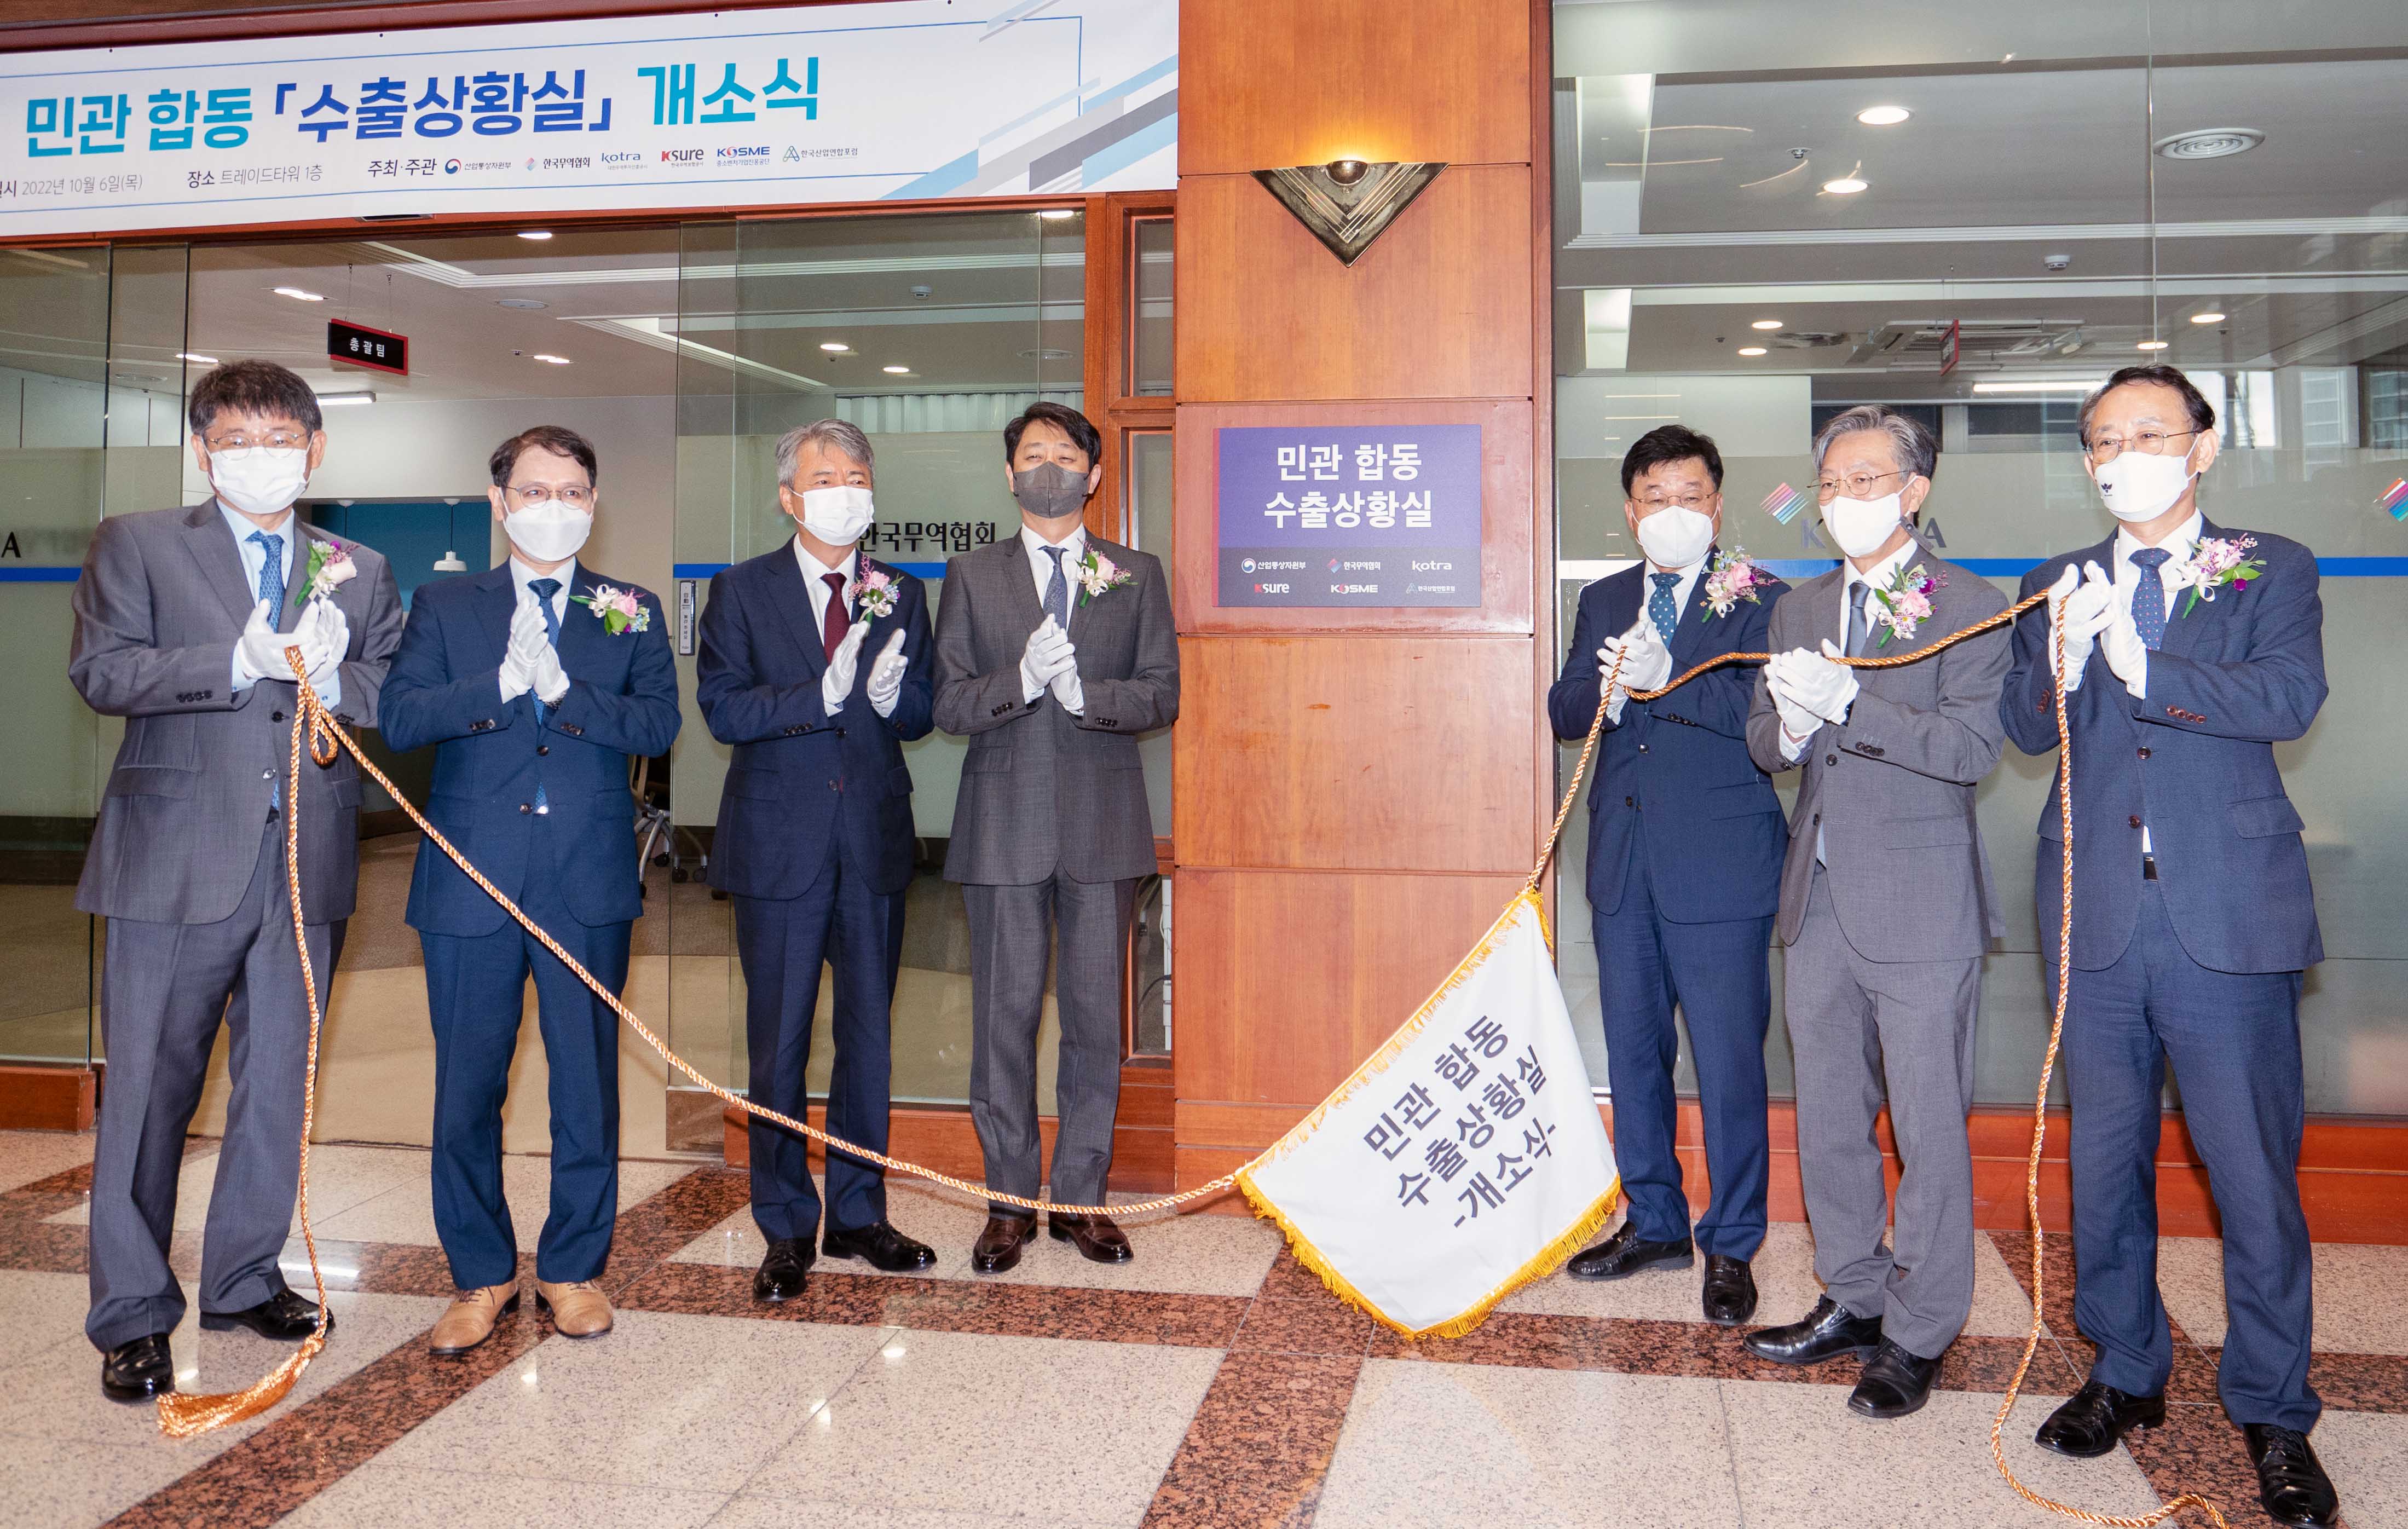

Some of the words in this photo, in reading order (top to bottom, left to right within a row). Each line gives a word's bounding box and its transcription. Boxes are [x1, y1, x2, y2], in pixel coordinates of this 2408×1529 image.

[27, 94, 131, 157] 민관
[148, 88, 252, 151] 합동
[638, 57, 819, 125] 개소식
[602, 152, 641, 163] kotra
[661, 149, 704, 161] Ksure
[717, 146, 770, 158] KOSME
[464, 161, 512, 171] 산업통상자원부
[543, 157, 591, 169] 한국무역협회
[187, 171, 215, 188] 장소
[220, 166, 300, 185] 트레이드타워
[306, 164, 323, 182] 1층
[0, 181, 16, 198] 시
[22, 178, 65, 195] 2022년
[70, 176, 95, 194] 10월
[100, 175, 143, 192] 6일(목)
[1277, 444, 1343, 481] 민관
[1355, 443, 1422, 481] 합동
[1264, 490, 1433, 529] 수출상황실
[1257, 561, 1307, 570] 산업통상자원부
[1412, 560, 1452, 572] kotra
[1331, 584, 1378, 595] KOSME
[1364, 1082, 1441, 1161] 민관
[1435, 1016, 1509, 1092] 합동
[1398, 1045, 1547, 1208] 수출상황실
